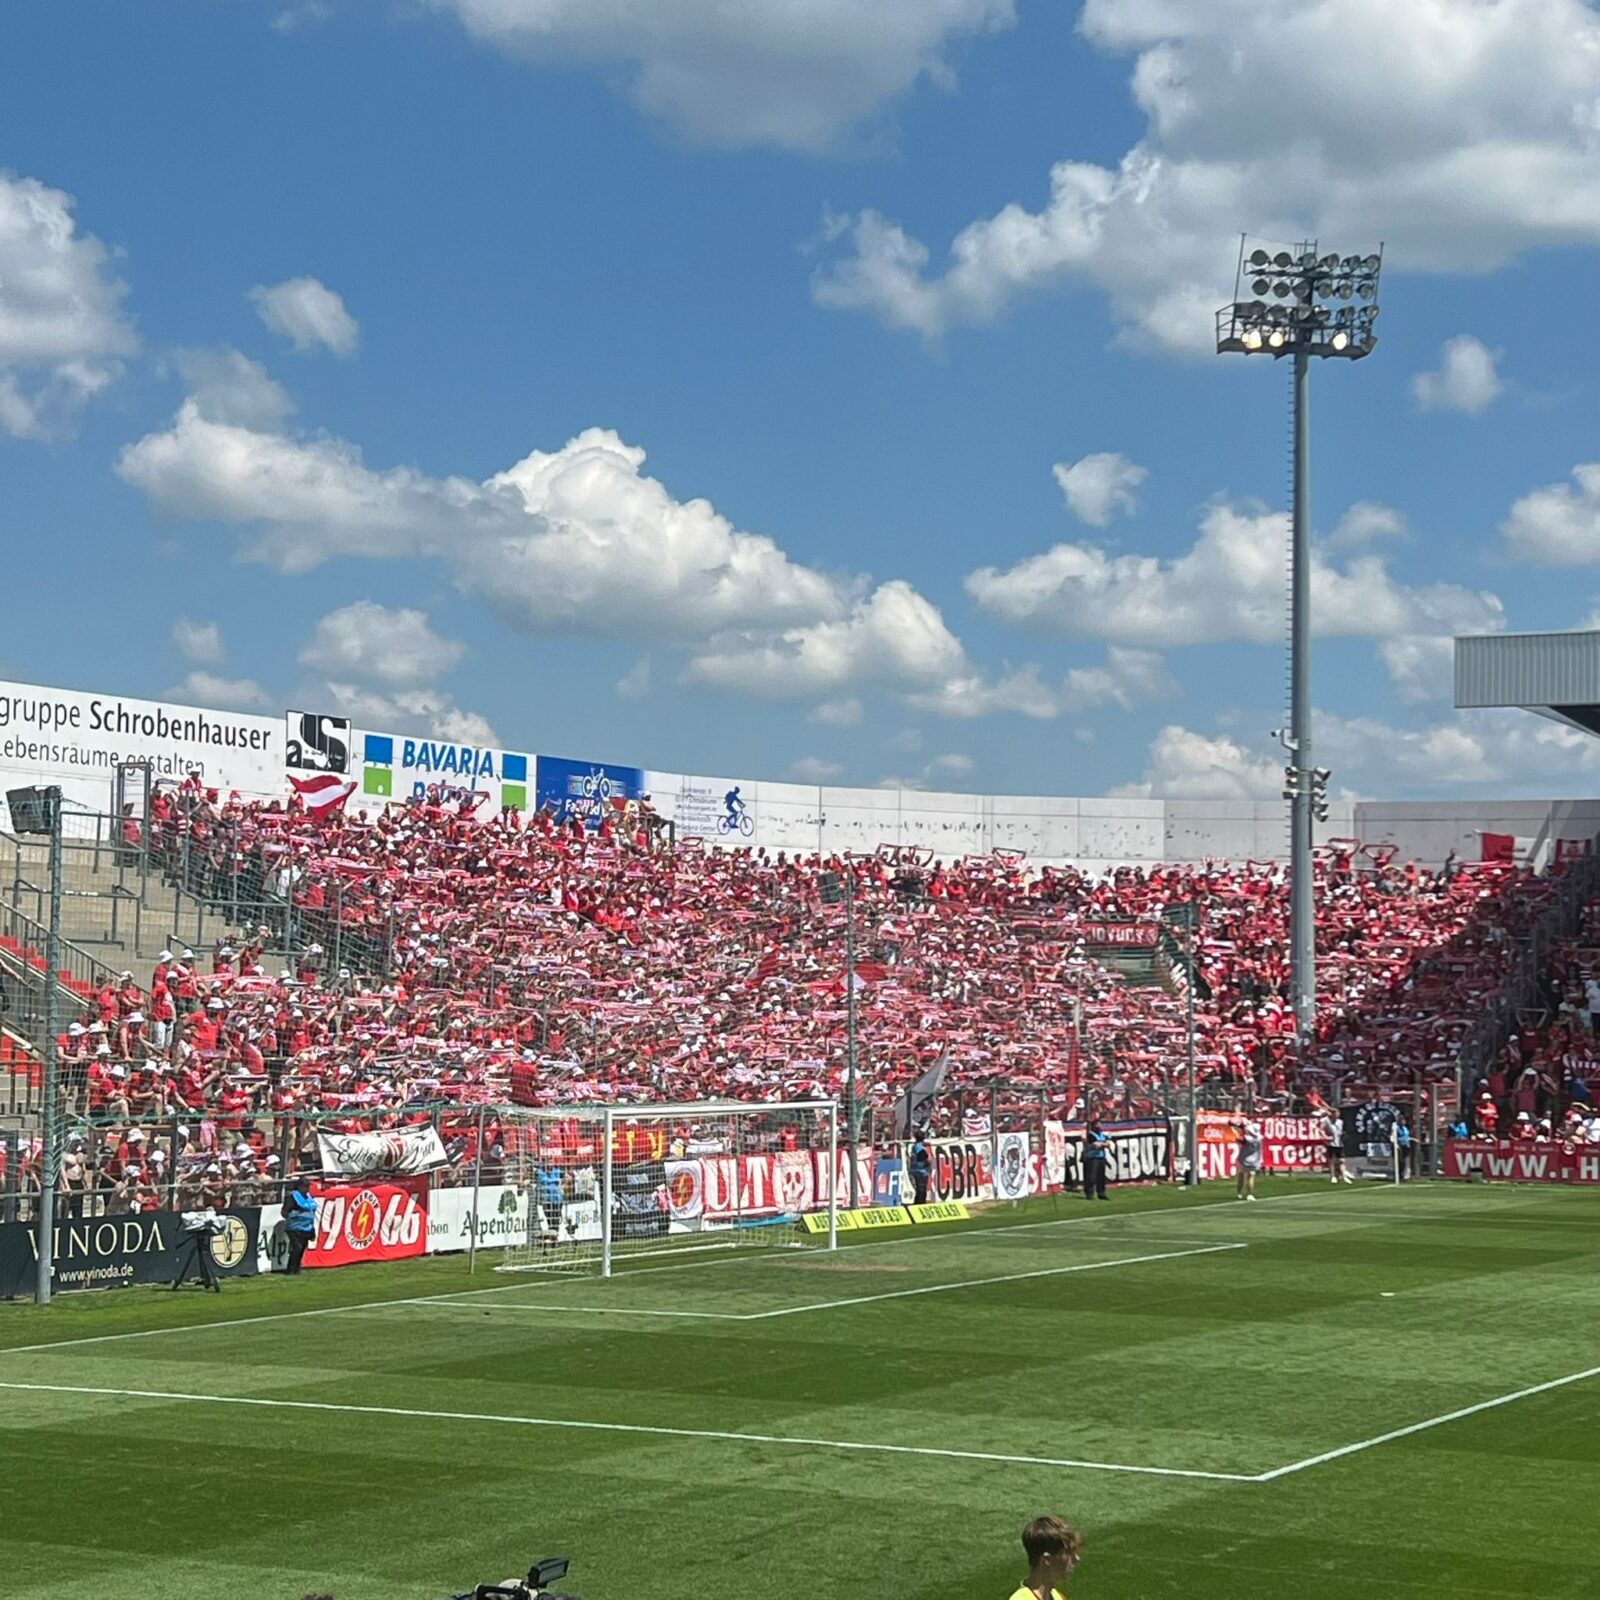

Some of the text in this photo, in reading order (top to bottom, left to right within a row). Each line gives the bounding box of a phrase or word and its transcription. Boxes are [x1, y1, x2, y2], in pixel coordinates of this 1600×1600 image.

[89, 700, 271, 751] Schrobenhauser
[0, 734, 119, 768] ebensräume
[402, 740, 493, 777] BAVARIA
[1268, 1144, 1327, 1164] TOUR
[935, 1144, 979, 1202] CBR
[381, 1193, 420, 1246] 66
[60, 1263, 134, 1285] www.vinoda.de
